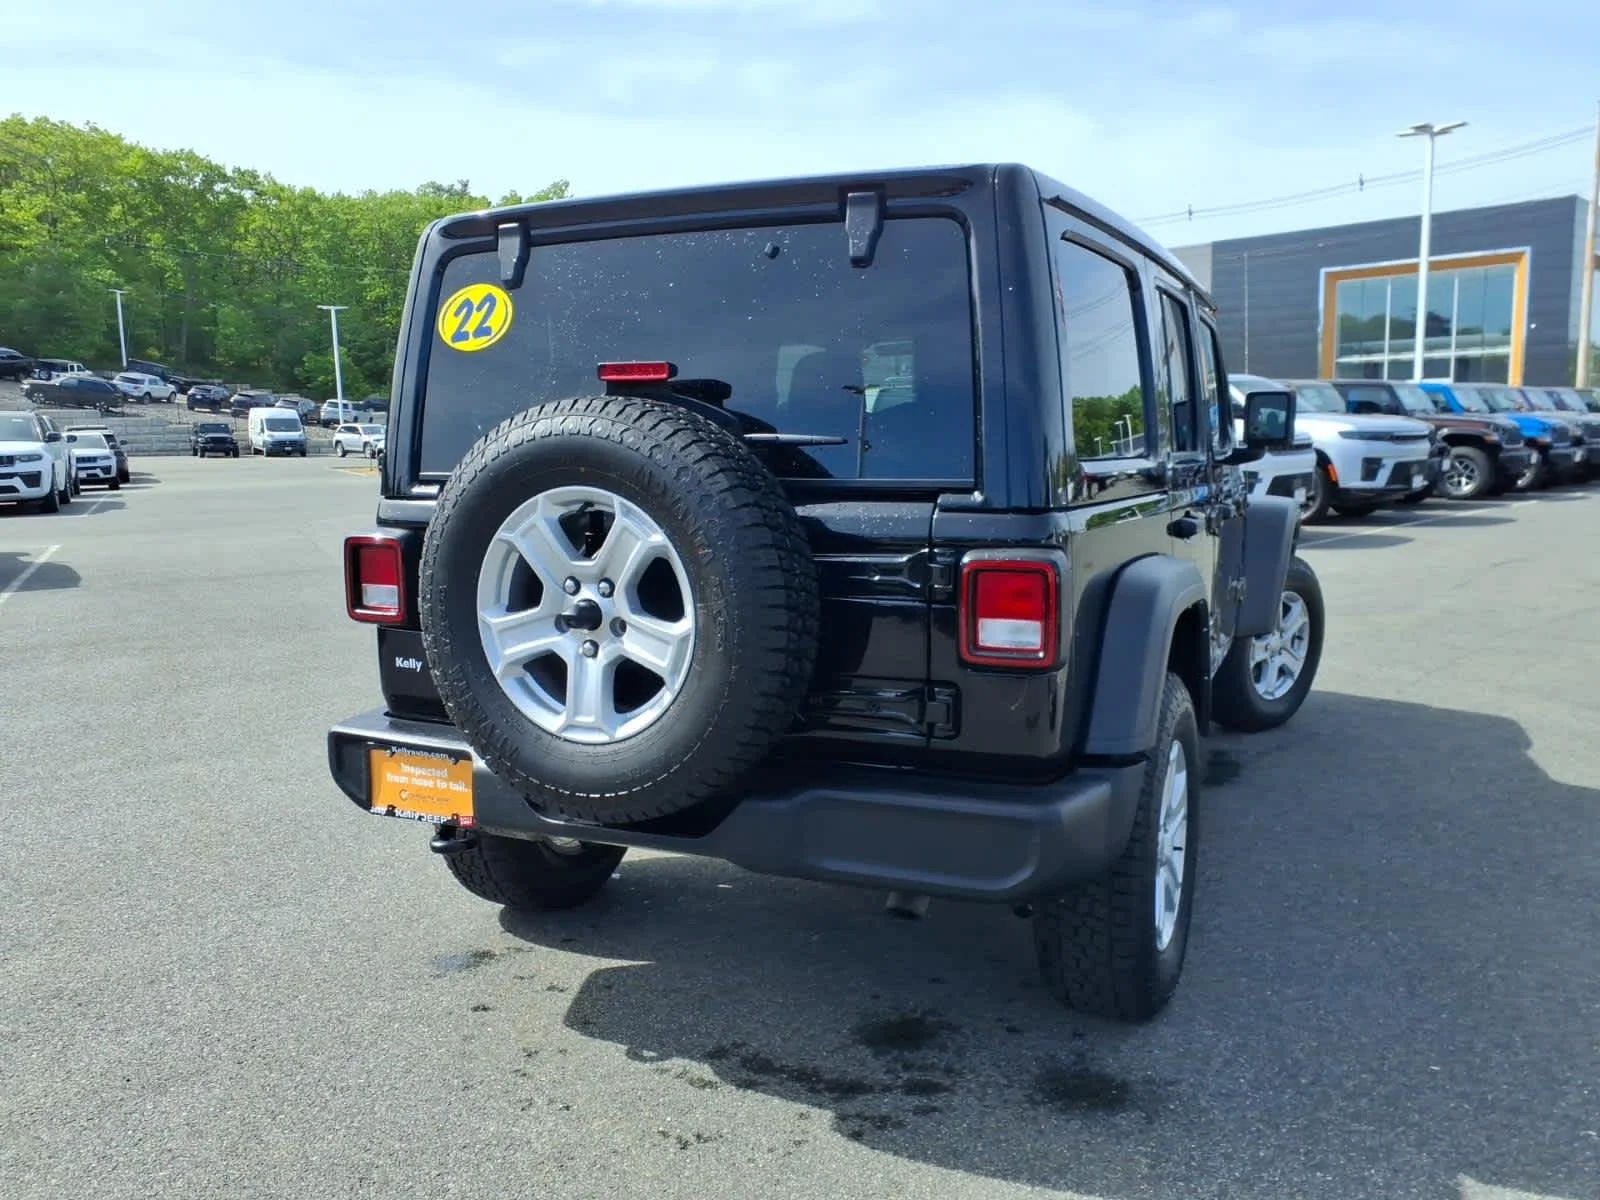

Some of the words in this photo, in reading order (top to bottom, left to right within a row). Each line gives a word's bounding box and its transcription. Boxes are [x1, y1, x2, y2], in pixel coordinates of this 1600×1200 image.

[451, 292, 497, 344] 22
[395, 656, 423, 673] Kelly
[400, 763, 448, 777] Inspected
[386, 773, 409, 784] from
[411, 777, 435, 787] nose
[436, 779, 448, 789] to
